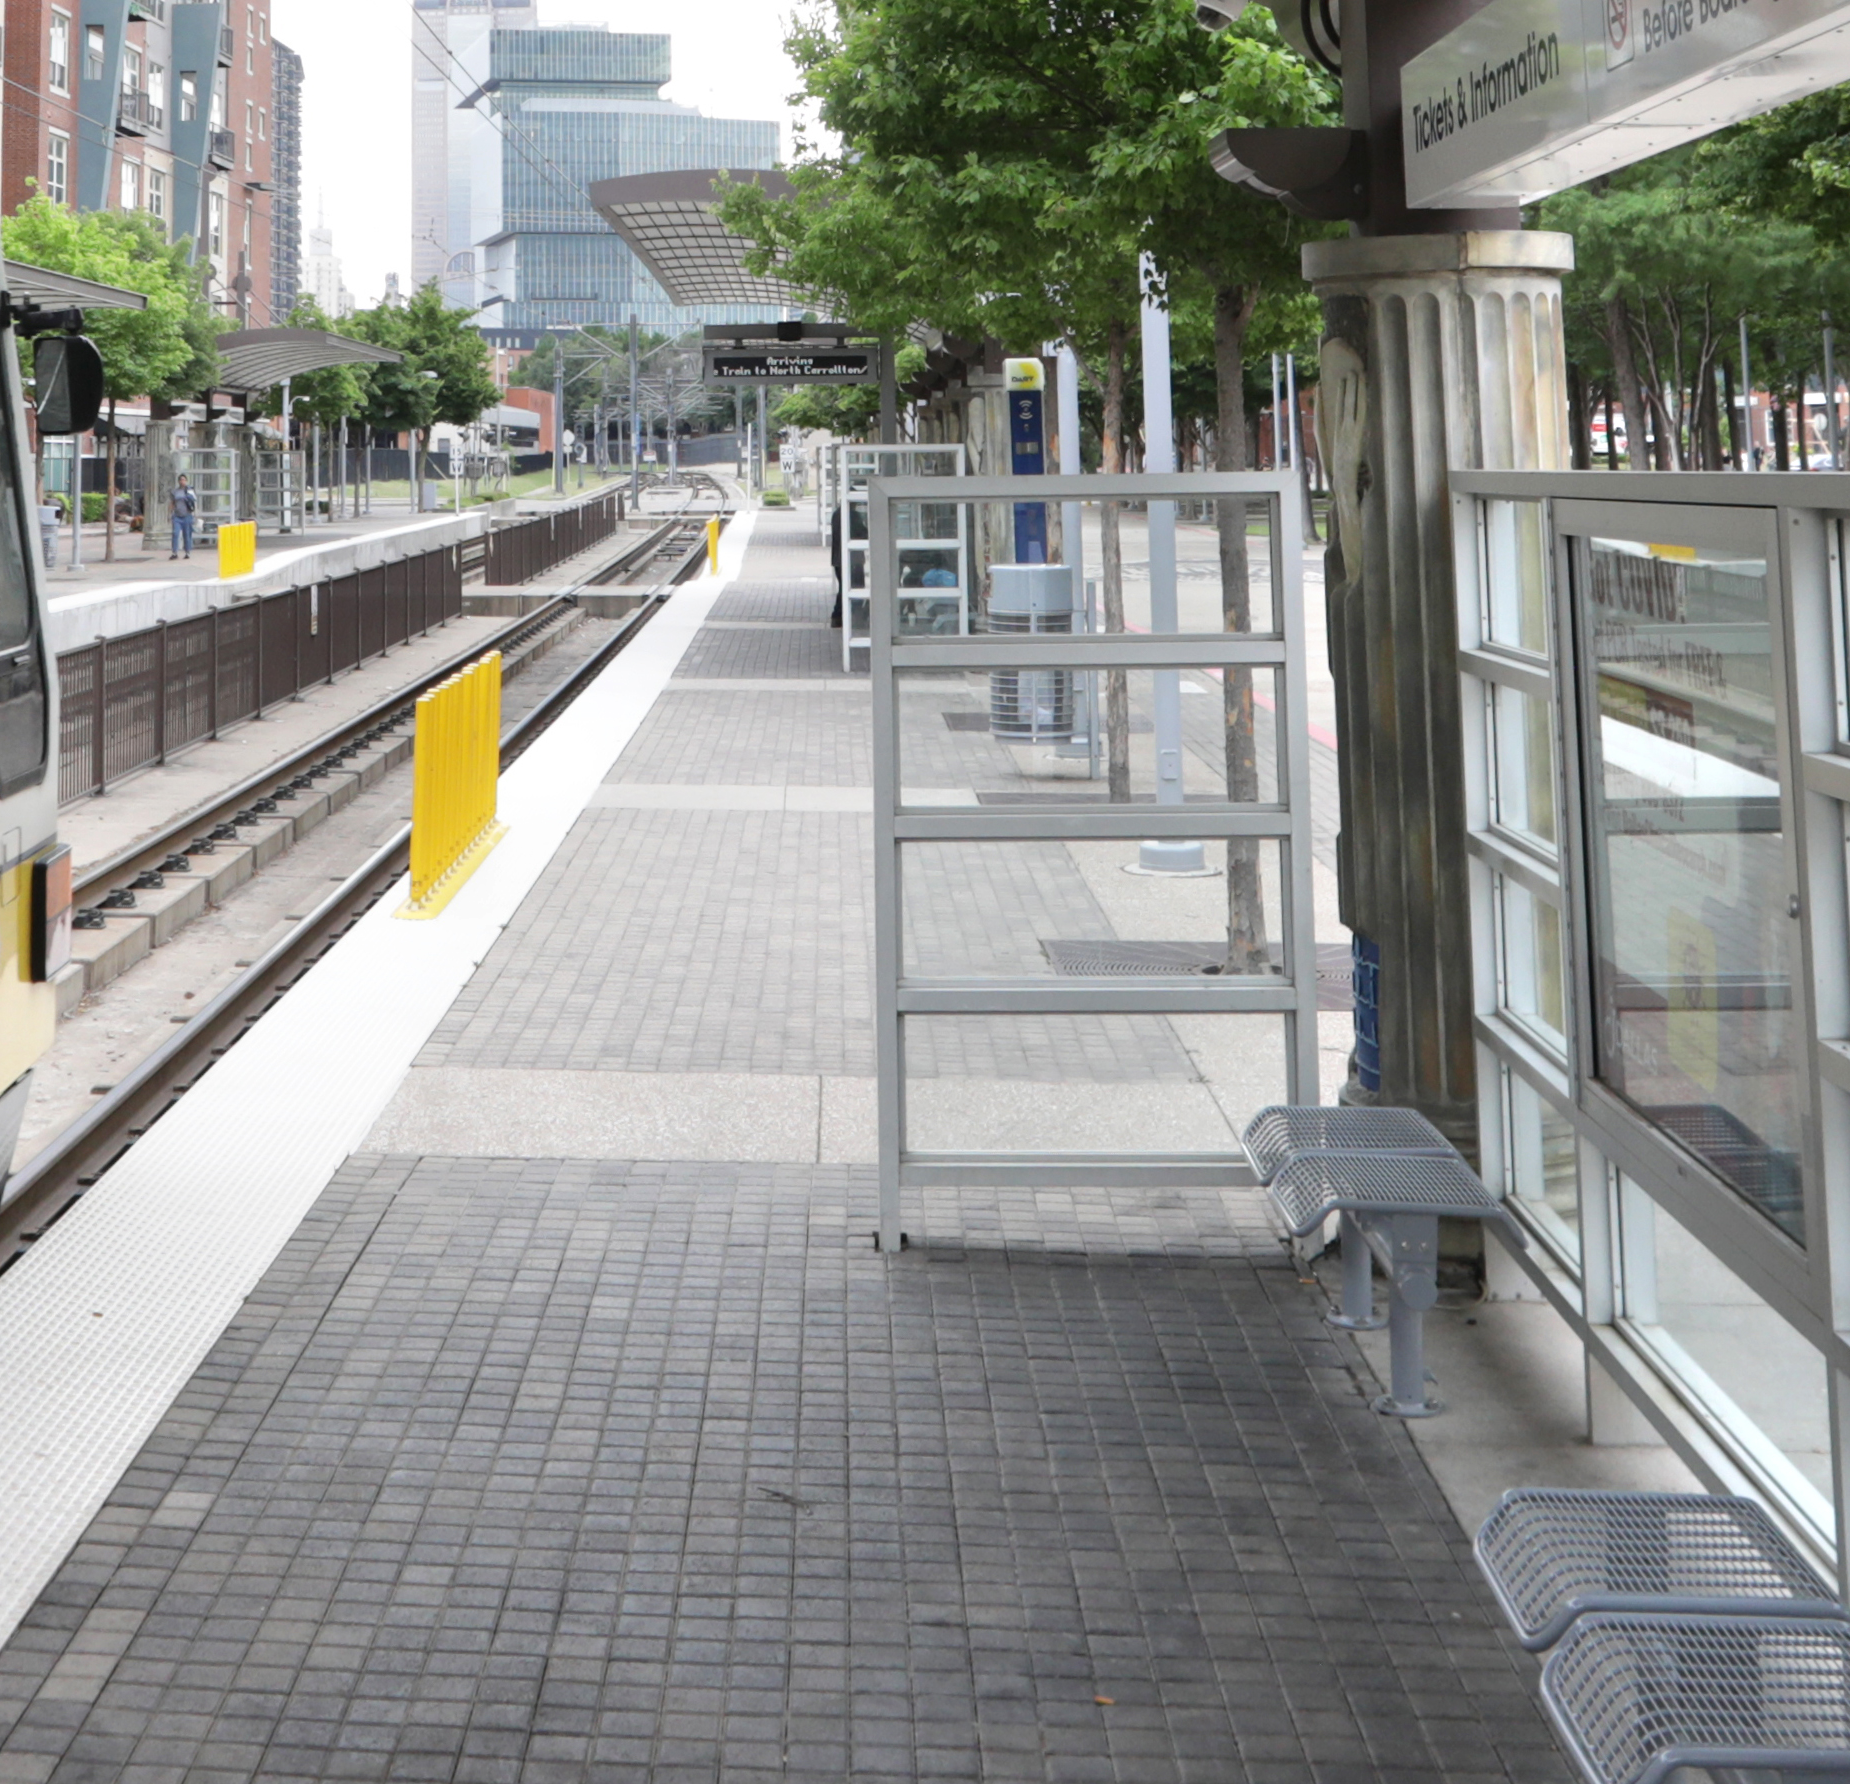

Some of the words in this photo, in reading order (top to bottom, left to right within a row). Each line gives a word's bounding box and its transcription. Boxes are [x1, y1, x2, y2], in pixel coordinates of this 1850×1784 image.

[1412, 86, 1454, 153] Tickets
[1457, 76, 1468, 129] &
[1470, 30, 1560, 123] Information
[766, 356, 814, 366] Arriving
[722, 367, 751, 376] Train
[755, 366, 767, 376] to
[769, 366, 801, 376] North
[781, 447, 794, 456] 20
[782, 461, 792, 471] W
